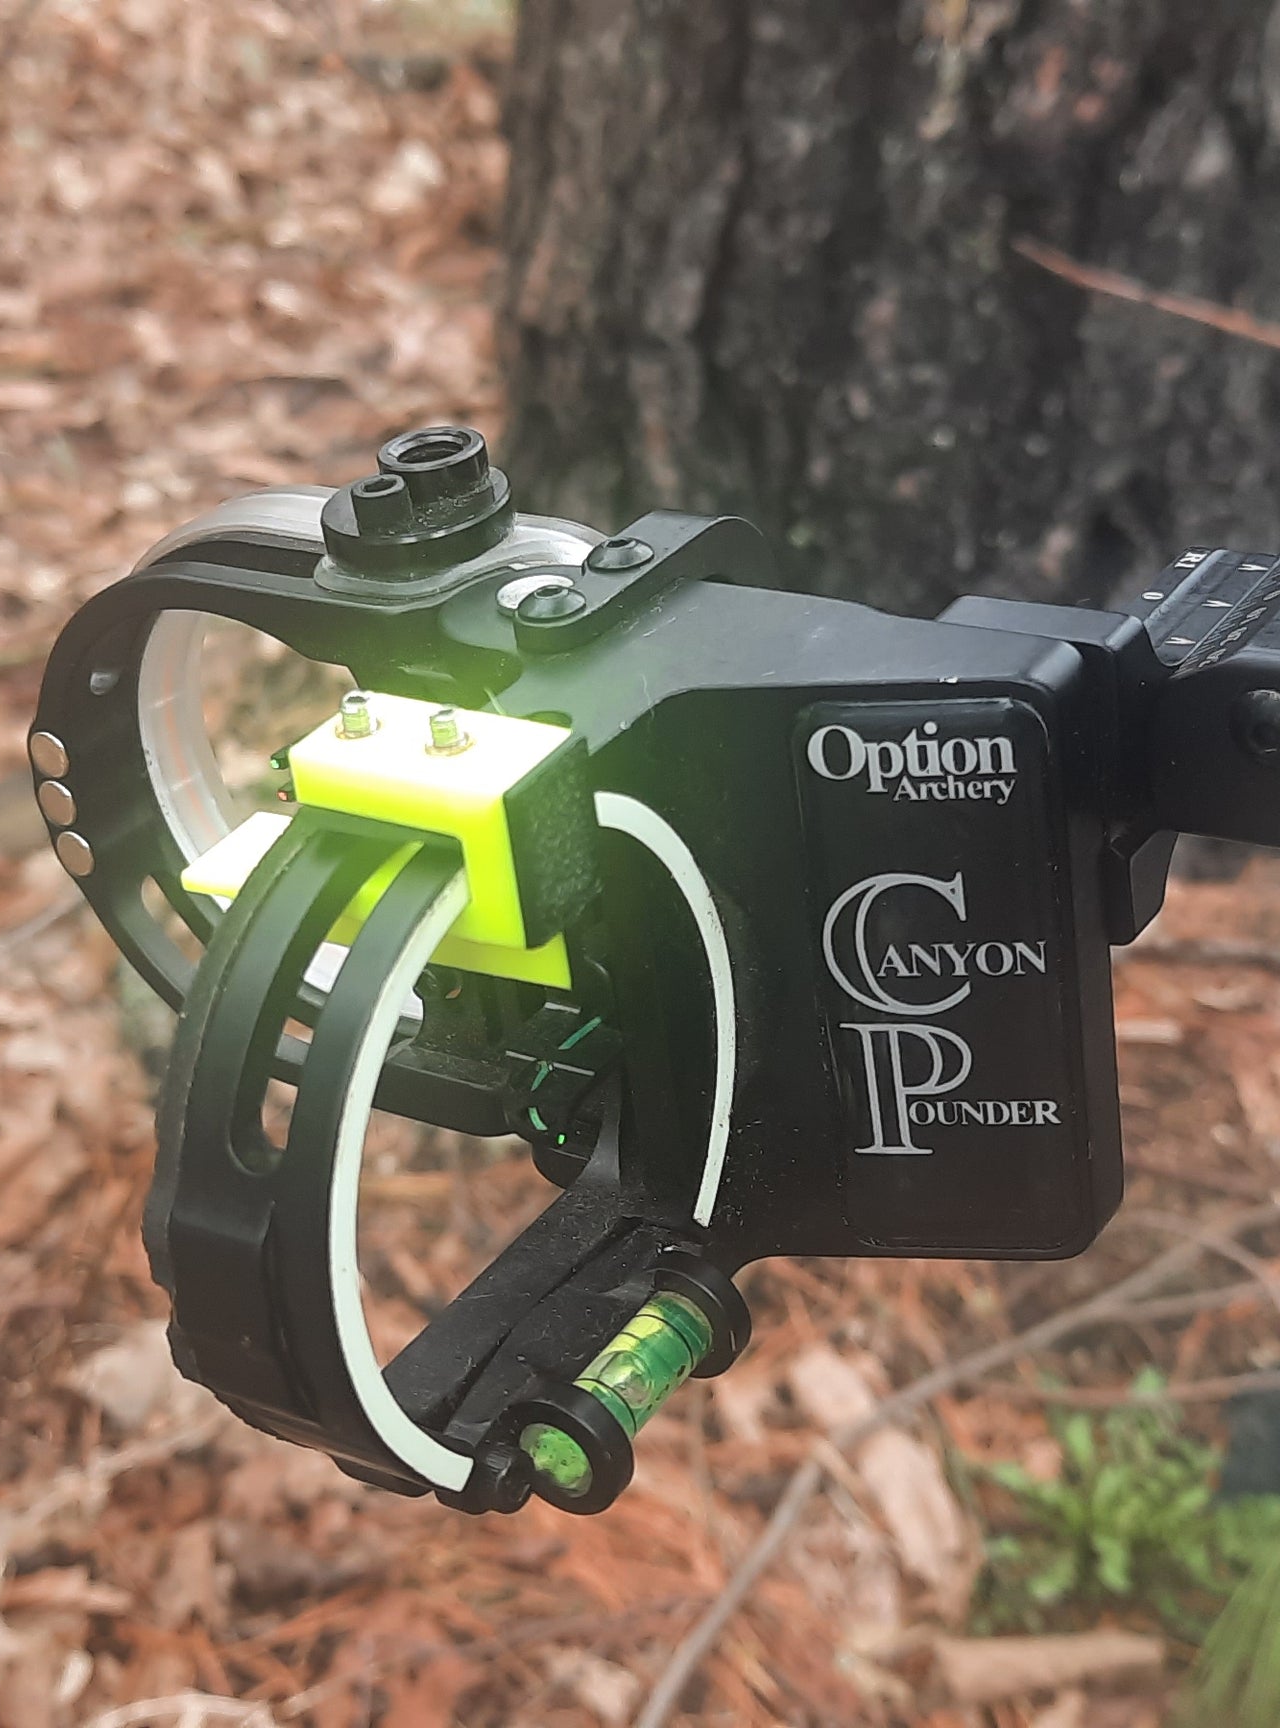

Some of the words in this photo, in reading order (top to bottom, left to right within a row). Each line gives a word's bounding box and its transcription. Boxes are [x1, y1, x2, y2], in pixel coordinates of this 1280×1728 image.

[807, 721, 1017, 794] Option
[893, 775, 1017, 805] Archery
[822, 871, 1047, 1016] CANYON
[839, 1022, 1062, 1156] POUNDER
